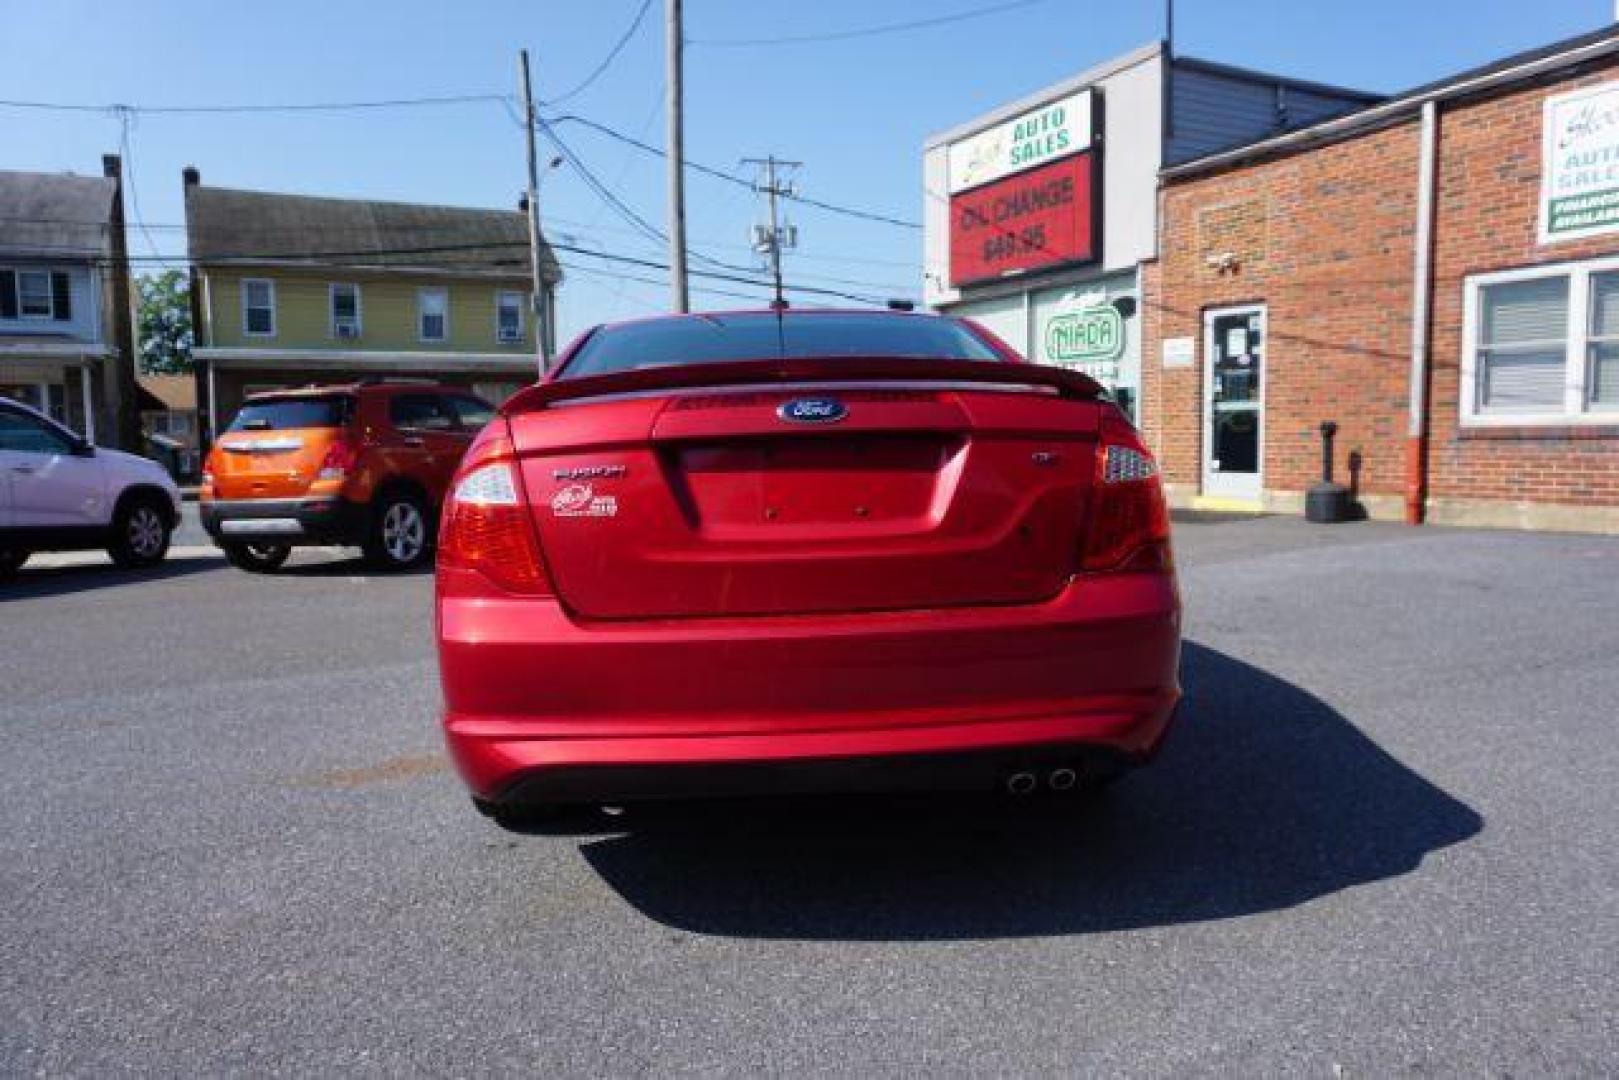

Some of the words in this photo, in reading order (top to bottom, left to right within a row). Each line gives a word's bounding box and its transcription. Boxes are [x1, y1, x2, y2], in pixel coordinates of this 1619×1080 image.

[1013, 106, 1066, 142] AUTO
[1010, 129, 1070, 165] SALES
[1563, 145, 1619, 169] AUT
[1557, 168, 1619, 189] SALE
[995, 176, 1073, 221] CHANGE
[1053, 320, 1112, 349] NIADA
[794, 401, 833, 416] Ford
